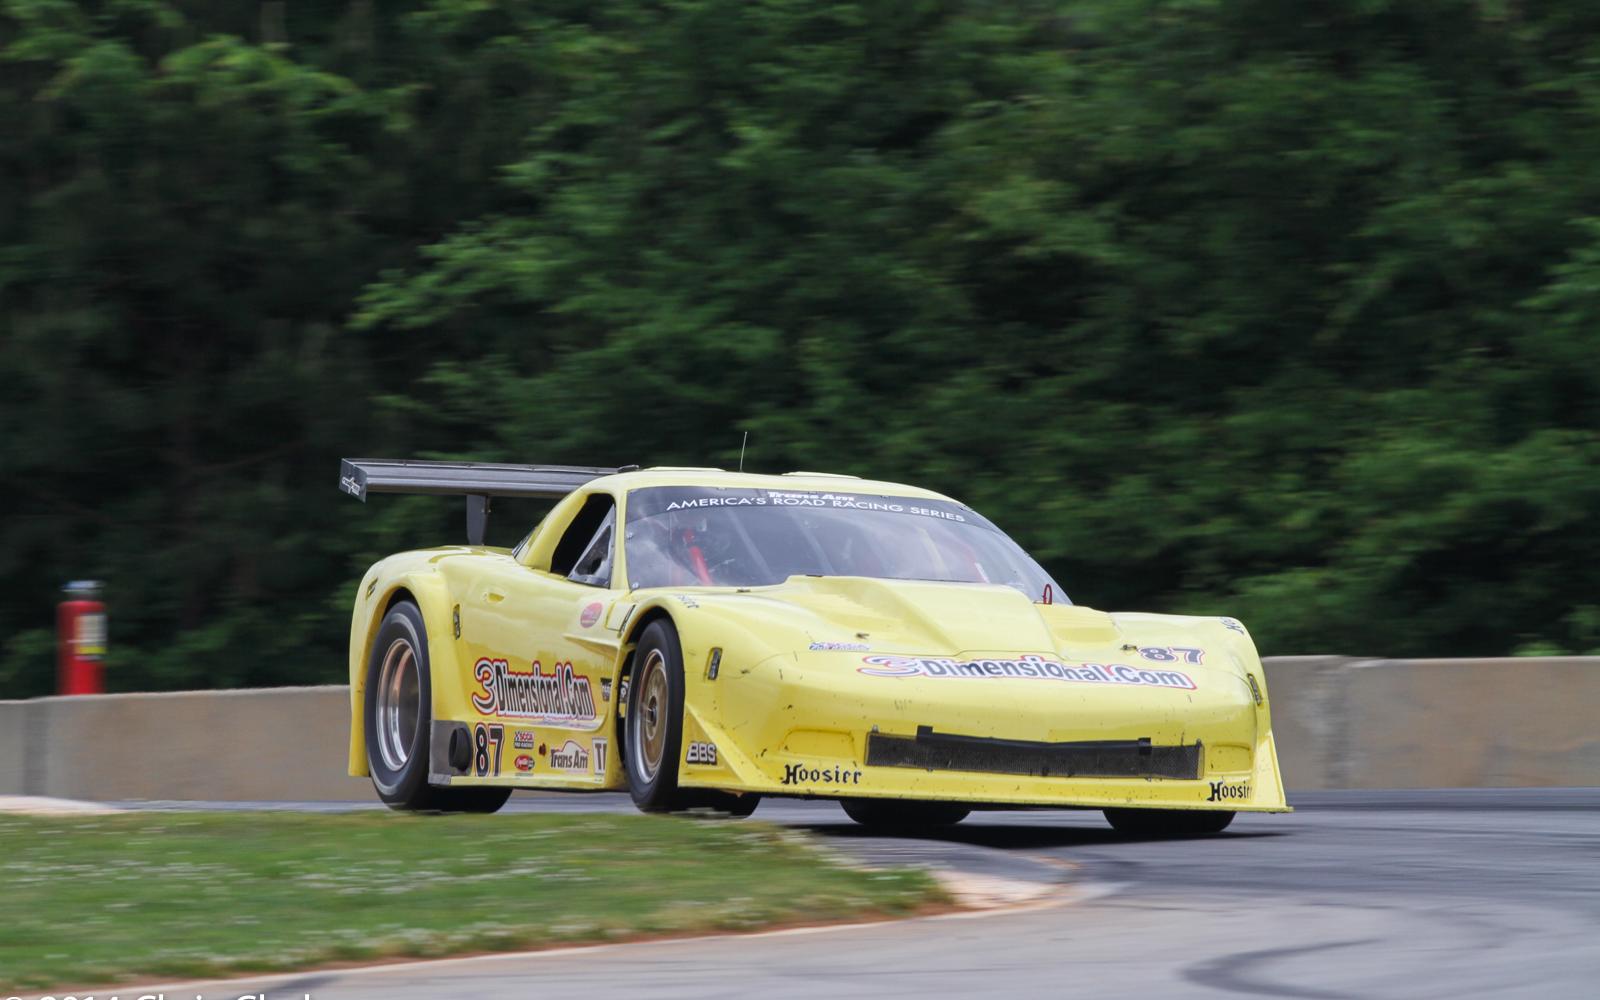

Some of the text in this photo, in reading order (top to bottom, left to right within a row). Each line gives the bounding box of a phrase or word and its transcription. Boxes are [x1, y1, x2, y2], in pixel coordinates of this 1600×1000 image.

[666, 497, 966, 522] AMERICA'S ROAD RACING SERIES
[1138, 647, 1205, 665] 87
[857, 655, 1197, 690] 3Dimensional.Com
[473, 658, 596, 719] 3Dimensional.Com
[475, 722, 505, 777] 87
[550, 749, 573, 768] Trans
[573, 750, 589, 769] Am
[686, 741, 717, 765] BBS
[780, 763, 863, 785] Hoosier
[1206, 780, 1253, 802] Hoosi
